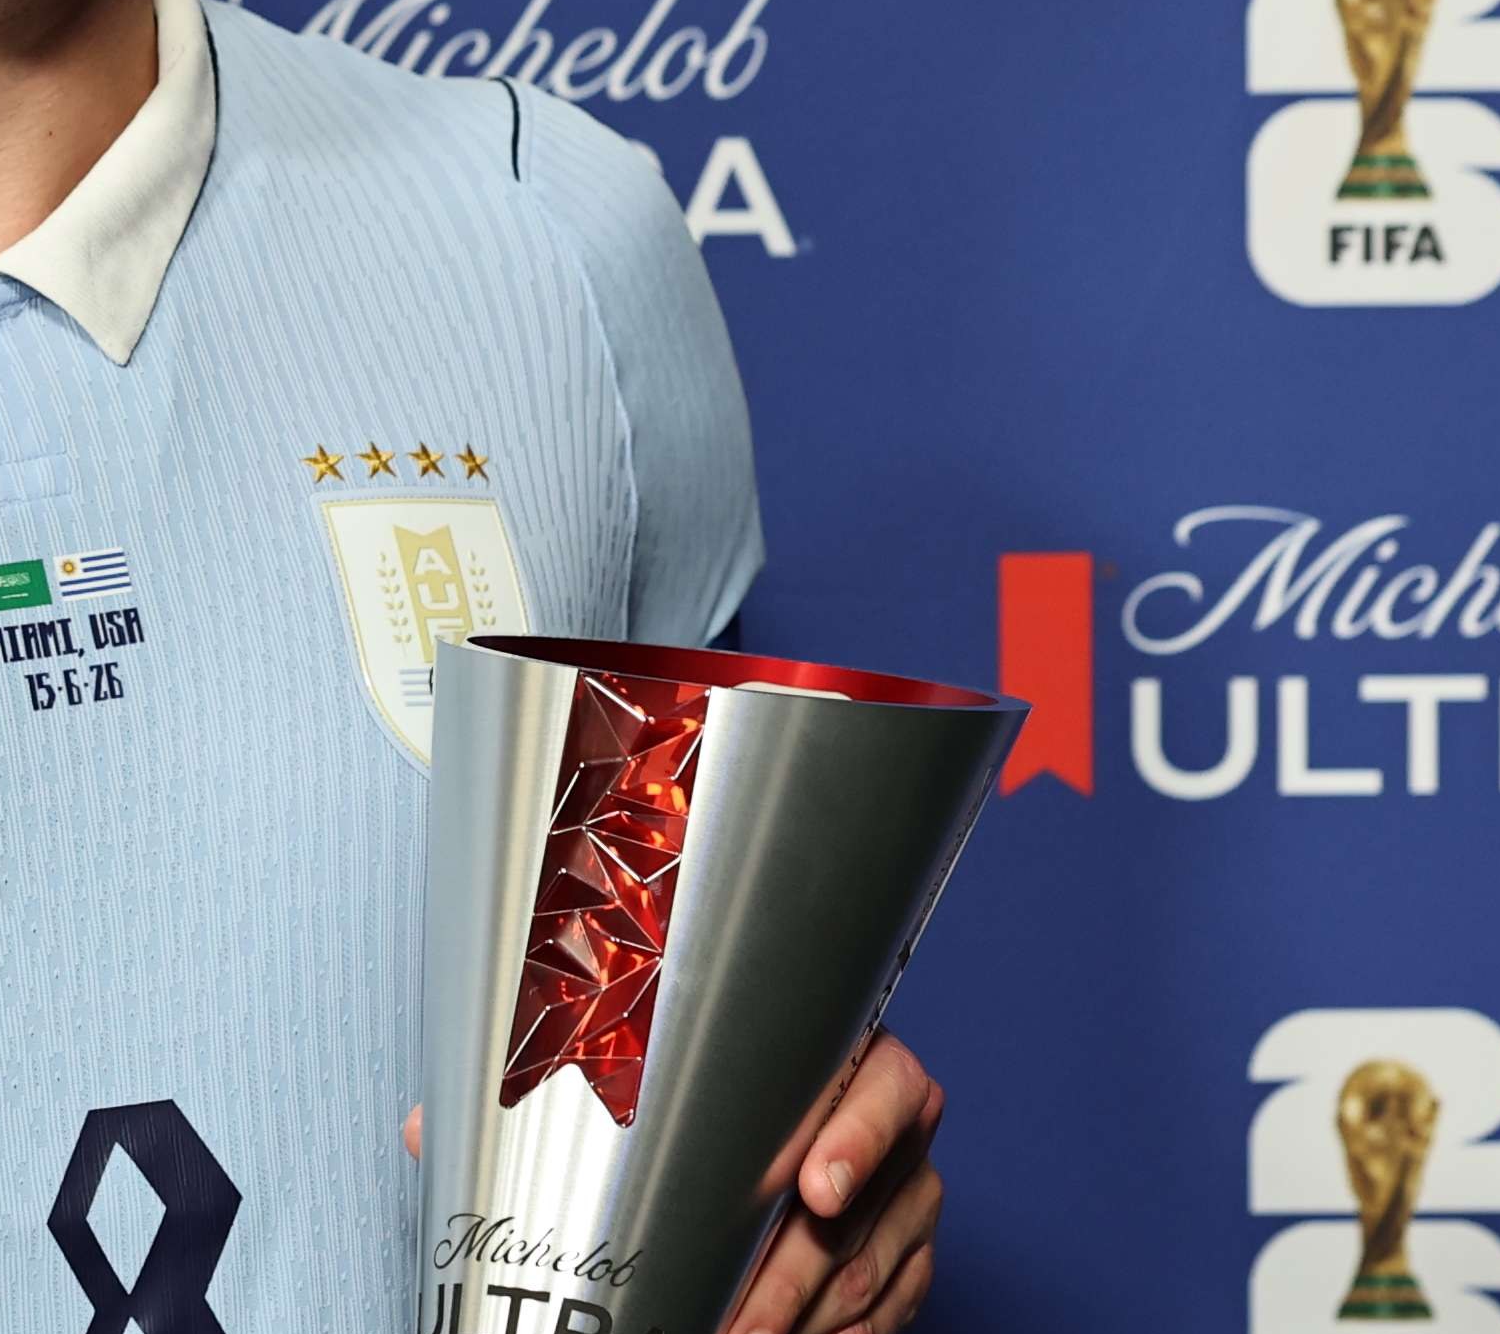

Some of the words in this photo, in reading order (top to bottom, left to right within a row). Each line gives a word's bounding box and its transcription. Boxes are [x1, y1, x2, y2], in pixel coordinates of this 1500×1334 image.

[1329, 224, 1445, 265] FIFA
[88, 607, 146, 650] USA
[432, 1212, 644, 1288] Michelob
